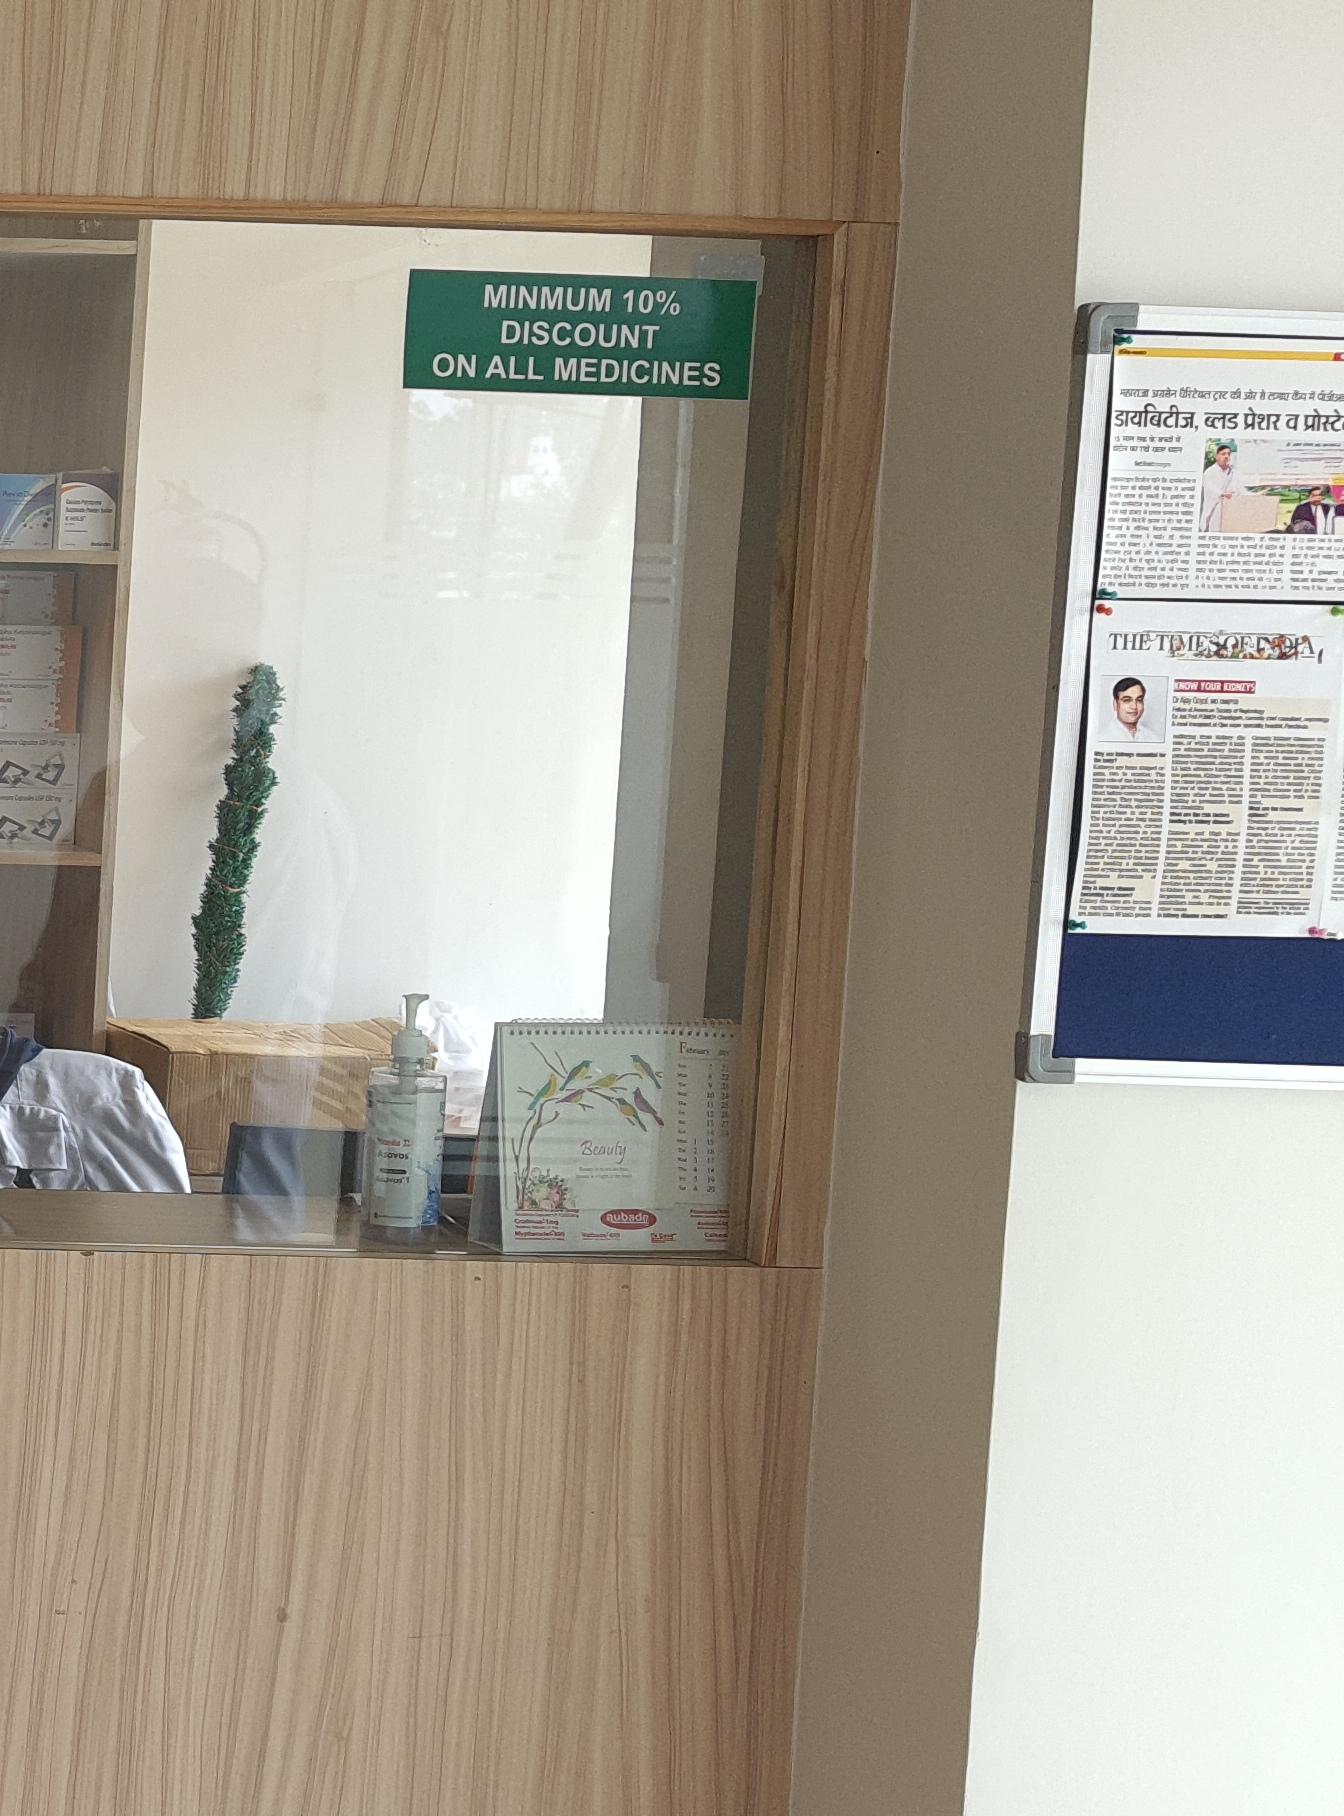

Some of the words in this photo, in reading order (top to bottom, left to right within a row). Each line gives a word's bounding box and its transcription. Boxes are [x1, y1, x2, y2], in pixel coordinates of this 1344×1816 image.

[483, 284, 612, 313] MINMUM
[622, 289, 681, 316] 10%
[500, 320, 660, 349] DISCOUNT
[432, 353, 476, 378] ON
[485, 355, 544, 380] ALL
[554, 357, 721, 387] MEDICINES
[1114, 403, 1198, 432] डायबिटीज,
[1205, 410, 1238, 430] ब्लड
[1244, 407, 1280, 431] प्रेशर
[1285, 413, 1299, 431] व
[1303, 407, 1344, 432] प्रोस्टे
[1109, 631, 1150, 652] THE
[1156, 632, 1220, 655] TIMES
[1224, 635, 1252, 654] OF
[1174, 681, 1198, 691] KNOW
[1200, 681, 1221, 691] YOUR
[580, 1139, 627, 1165] Beauty
